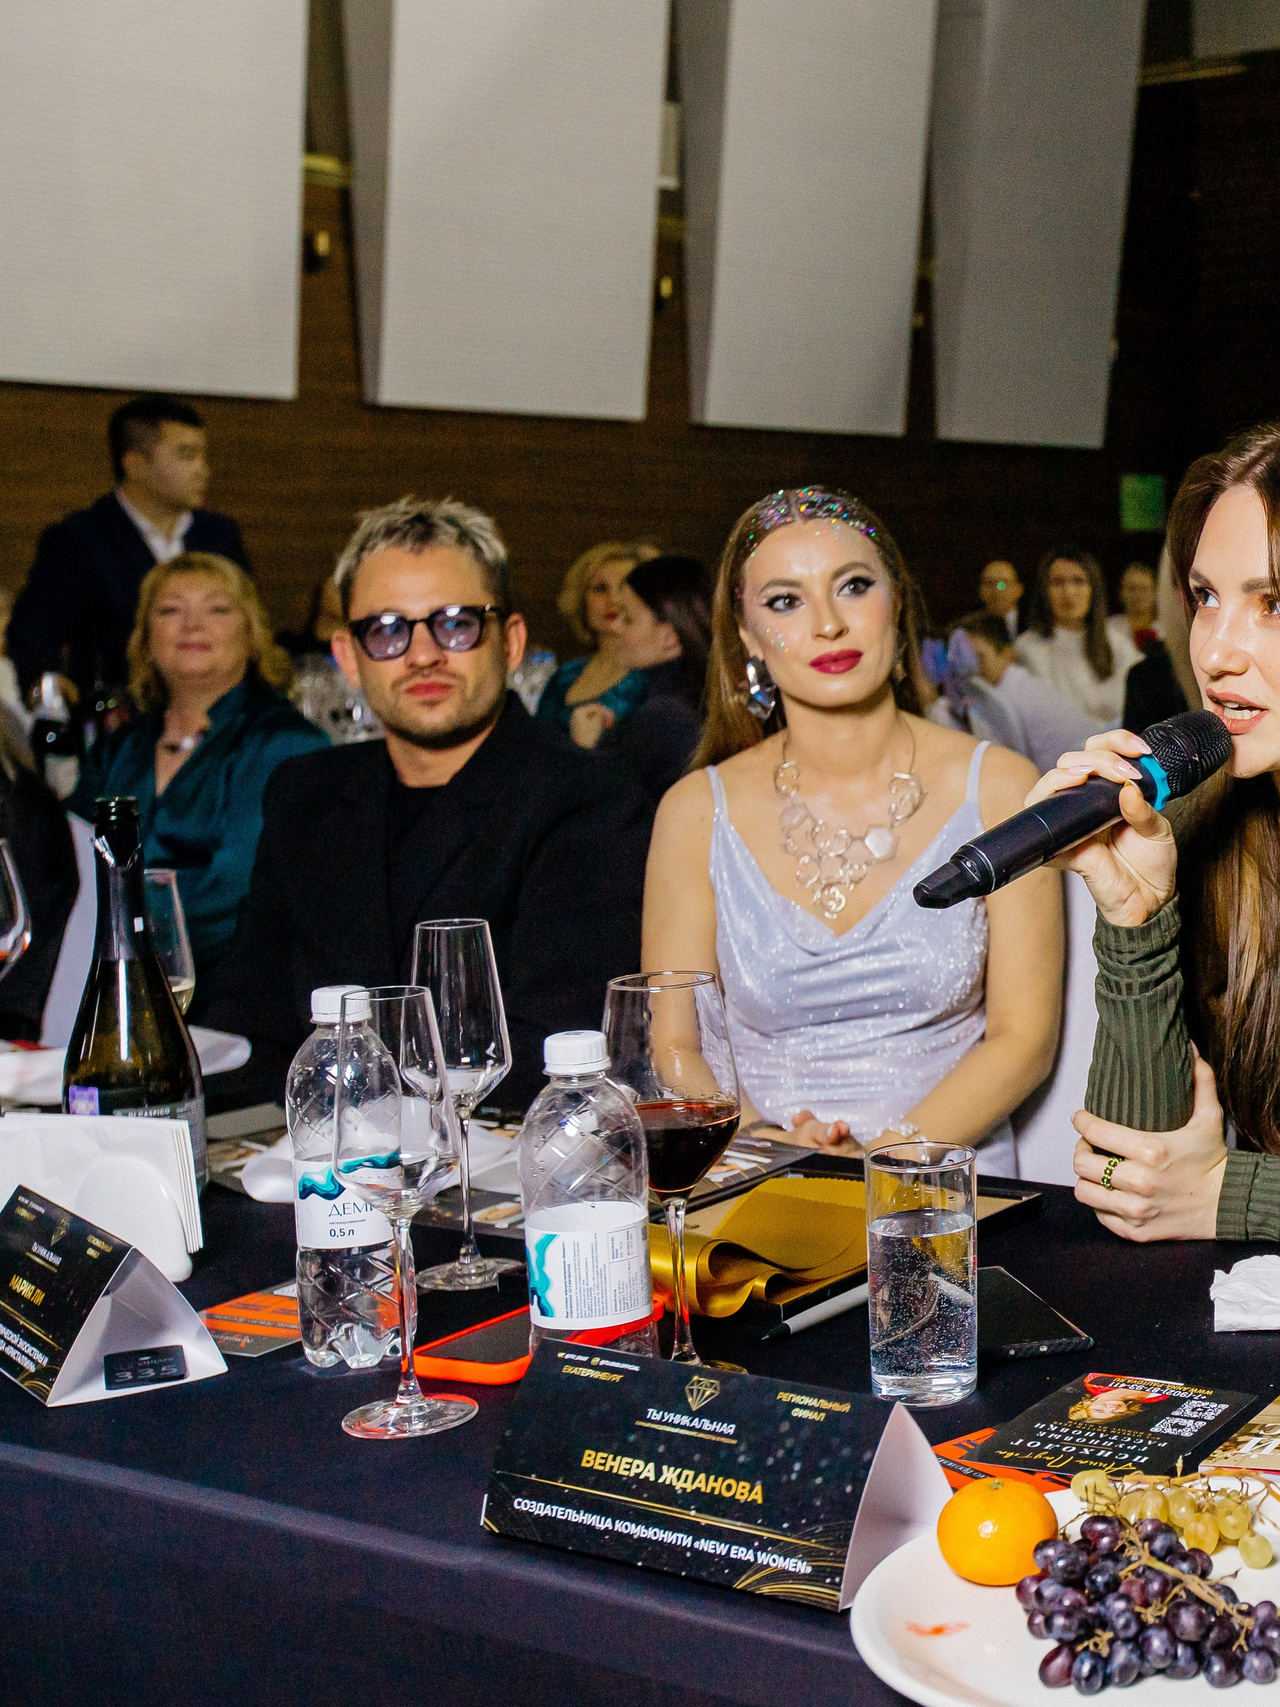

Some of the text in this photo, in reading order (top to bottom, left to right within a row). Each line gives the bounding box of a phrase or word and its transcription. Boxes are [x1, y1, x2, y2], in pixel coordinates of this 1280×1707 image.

[329, 1228, 346, 1238] 0,5
[9, 1274, 46, 1306] МАРИЯ ЛИ
[561, 1364, 625, 1383] ЕКАТЕРИНБУРГ
[776, 1391, 851, 1413] РЕГИОНАЛЬНЫЙ
[791, 1407, 826, 1422] ФИНАЛ
[645, 1408, 662, 1421] ТЫ
[662, 1411, 737, 1436] УНИКАЛЬНАЯ
[1033, 1422, 1168, 1448] РАССТАНОВКИ
[1009, 1437, 1150, 1464] ПСИХОЛОГ
[1036, 1430, 1148, 1452] ГРУППОВЫЕ
[580, 1449, 763, 1505] ВЕНЕРА ЖДАНОВА
[513, 1497, 813, 1574] СОЗДАТЕЛЬНИЦА КОМЬЮНИТИ «NEW ERA WOMEN»
